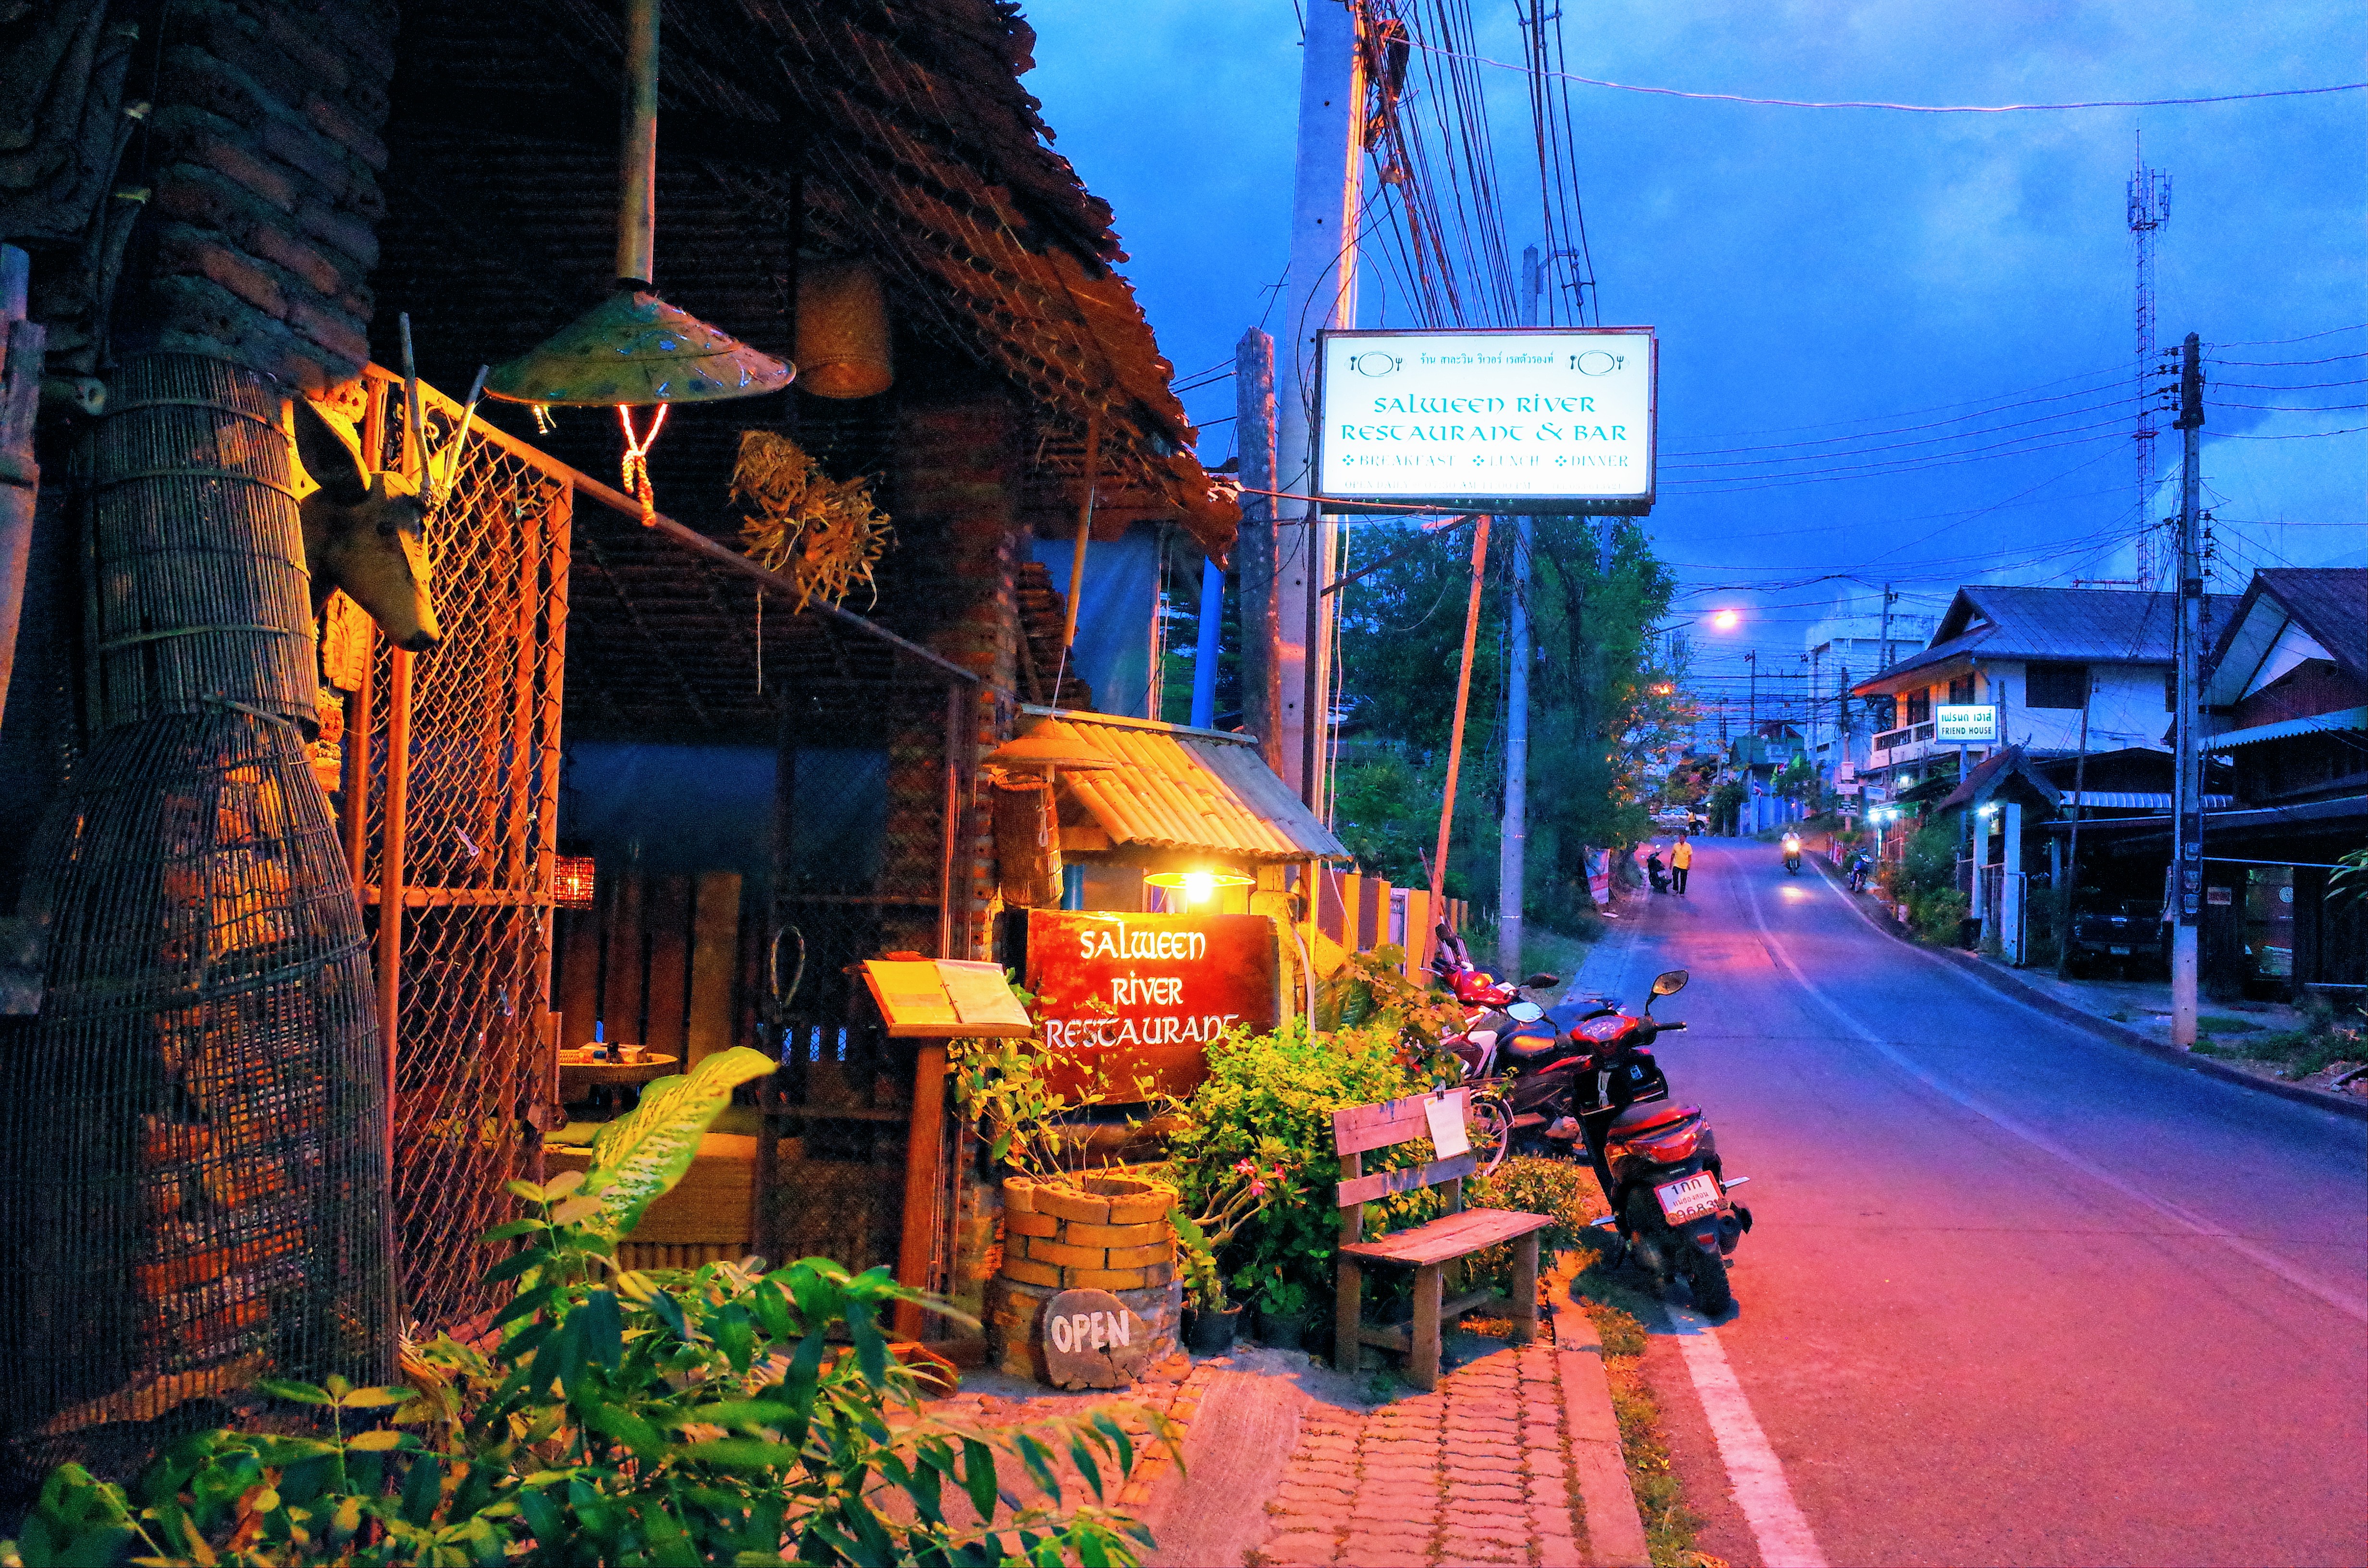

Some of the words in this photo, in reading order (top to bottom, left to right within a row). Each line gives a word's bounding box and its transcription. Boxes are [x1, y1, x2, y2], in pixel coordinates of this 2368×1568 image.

[1420, 353, 1435, 364] ร้าน
[1440, 353, 1473, 364] สาละวิน
[1477, 351, 1502, 364] ริเวอร์
[1374, 394, 1504, 415] SALWEEN
[1341, 424, 1525, 442] RESTAURANT
[1536, 422, 1563, 441] &
[1574, 425, 1627, 441] BAR
[1360, 455, 1456, 466] BREAKFAST
[1490, 455, 1539, 467] LUNCH
[1572, 454, 1628, 467] DINNER
[1345, 480, 1373, 489] OPEN
[1377, 480, 1408, 489] DAILY
[1515, 480, 1530, 490] PM
[1969, 726, 1991, 735] HOUSE
[1080, 921, 1206, 960] SALWEEN
[1677, 1200, 1716, 1218] 9683
[1051, 1310, 1130, 1354] OPEN
